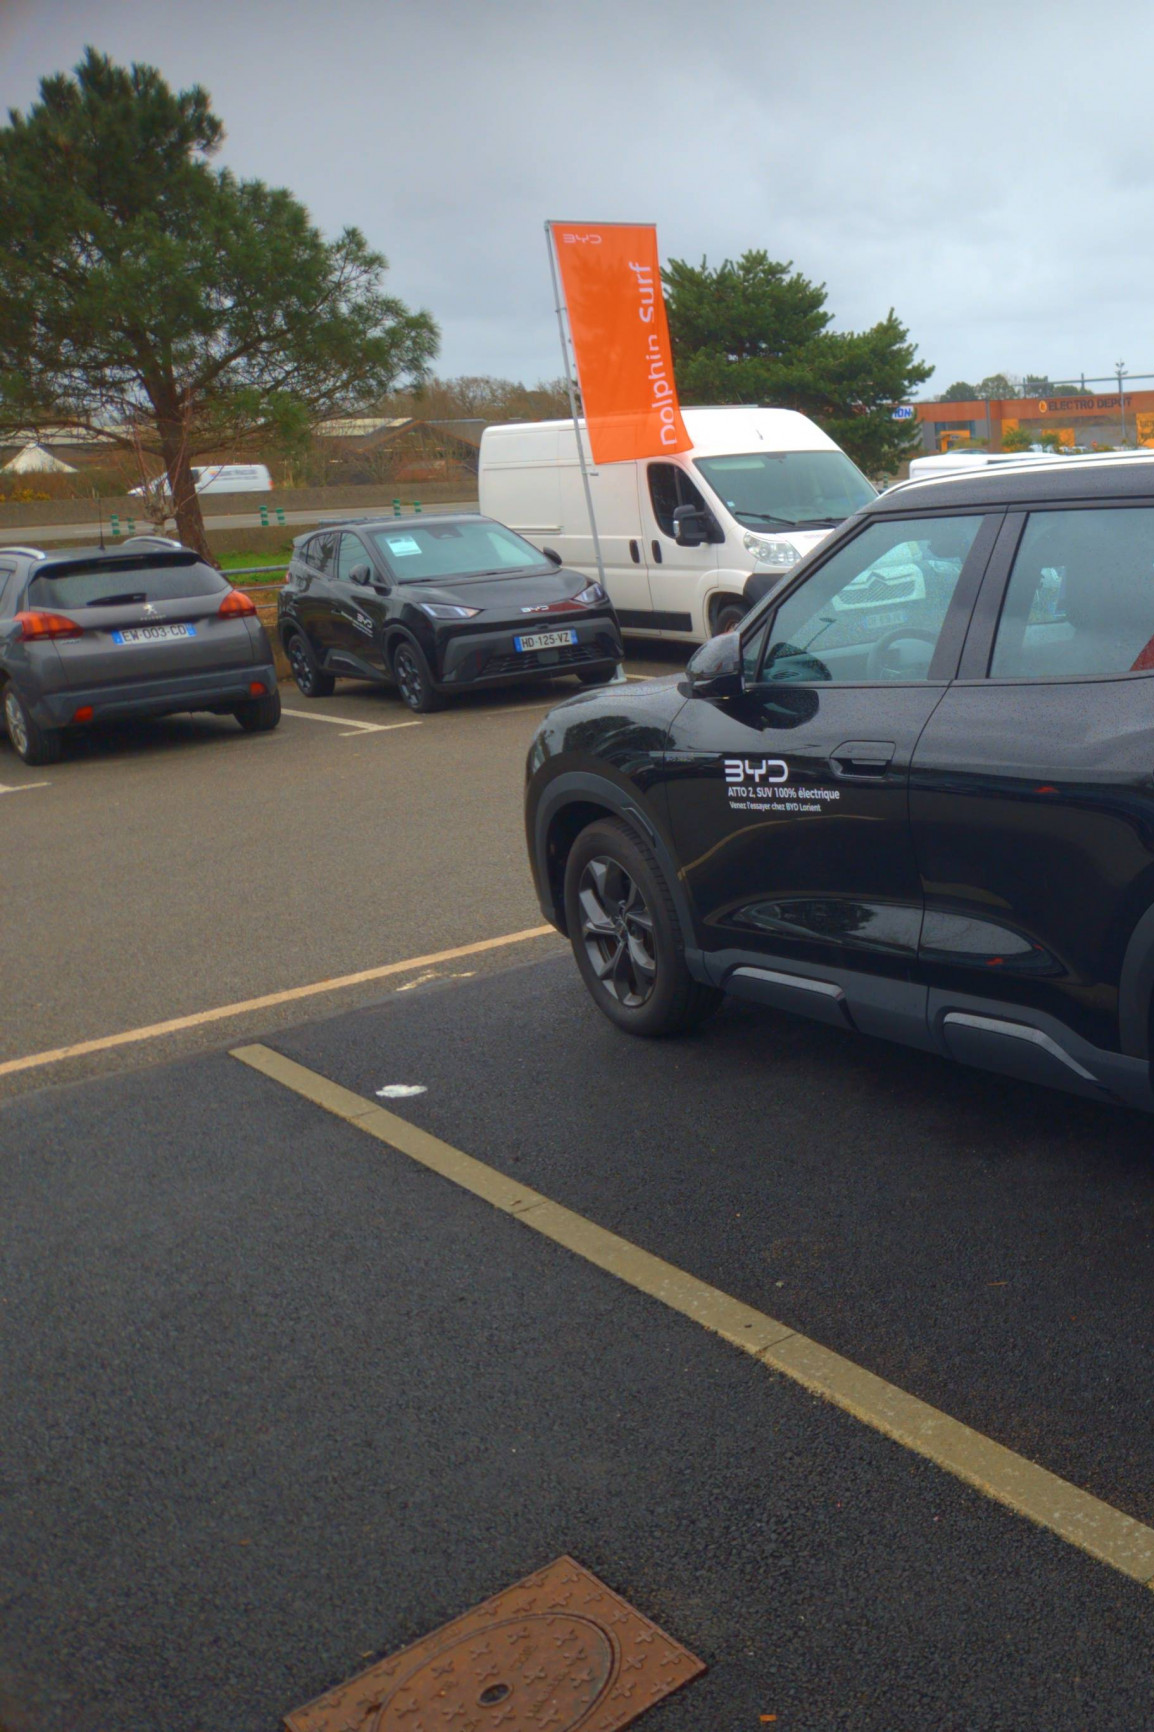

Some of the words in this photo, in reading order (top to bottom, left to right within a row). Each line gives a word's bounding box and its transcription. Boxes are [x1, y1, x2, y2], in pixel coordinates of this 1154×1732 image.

[563, 233, 602, 244] BYD
[1048, 399, 1095, 411] ELECTRO
[121, 624, 188, 642] EW-003-CD
[521, 632, 570, 649] HD-125-VZ
[724, 759, 789, 783] BYD
[728, 786, 747, 797] ATTO
[756, 787, 773, 798] SUV
[774, 787, 797, 799] 100%
[798, 787, 840, 802] électrique
[729, 801, 747, 810] Venez
[771, 803, 786, 811] chez
[786, 803, 799, 811] BYD
